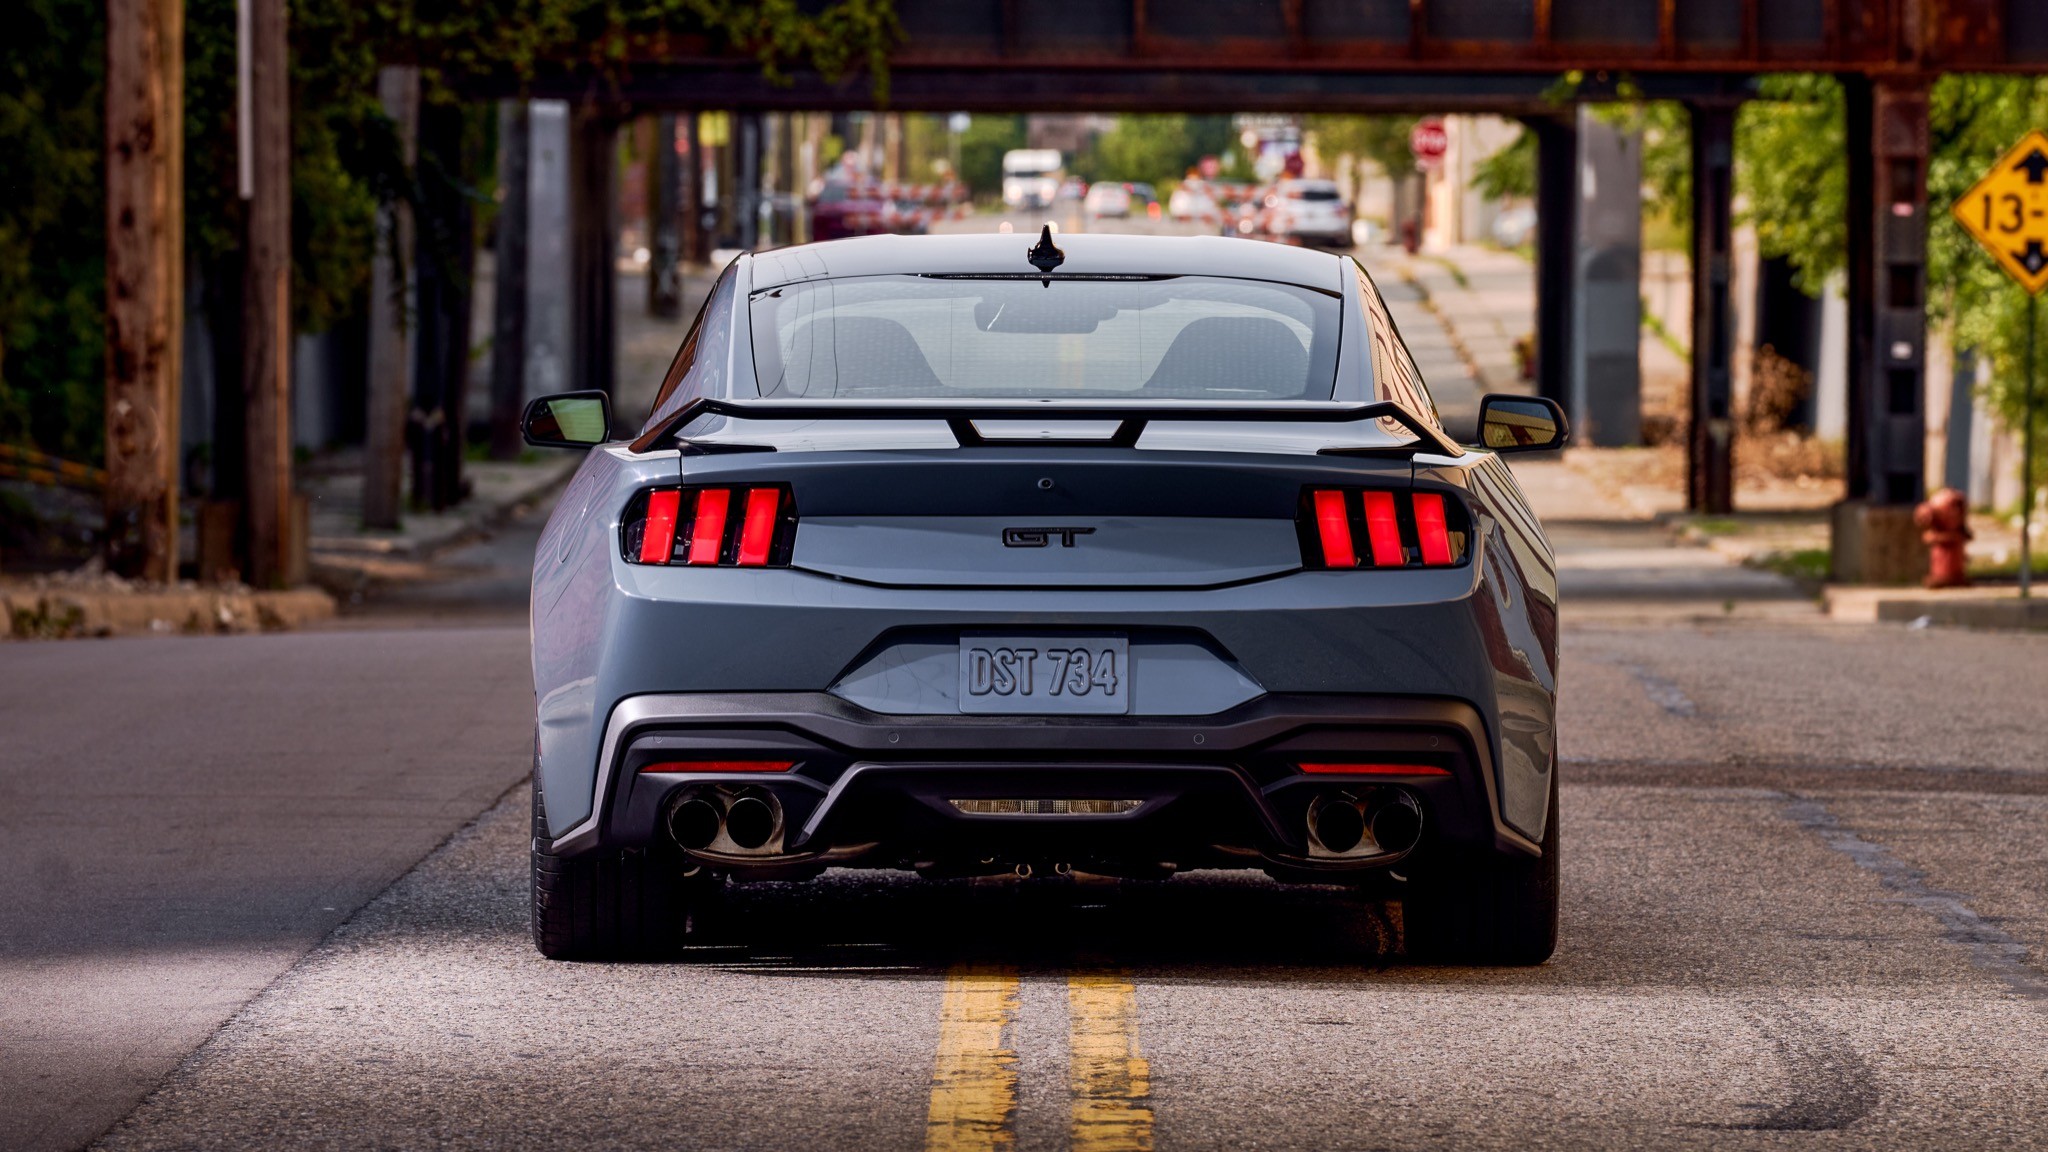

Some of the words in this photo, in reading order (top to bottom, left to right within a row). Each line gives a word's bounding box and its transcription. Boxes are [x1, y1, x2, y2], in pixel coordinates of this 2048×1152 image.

[1002, 527, 1097, 548] GT
[969, 647, 1038, 696] DST
[1047, 648, 1118, 696] 734
